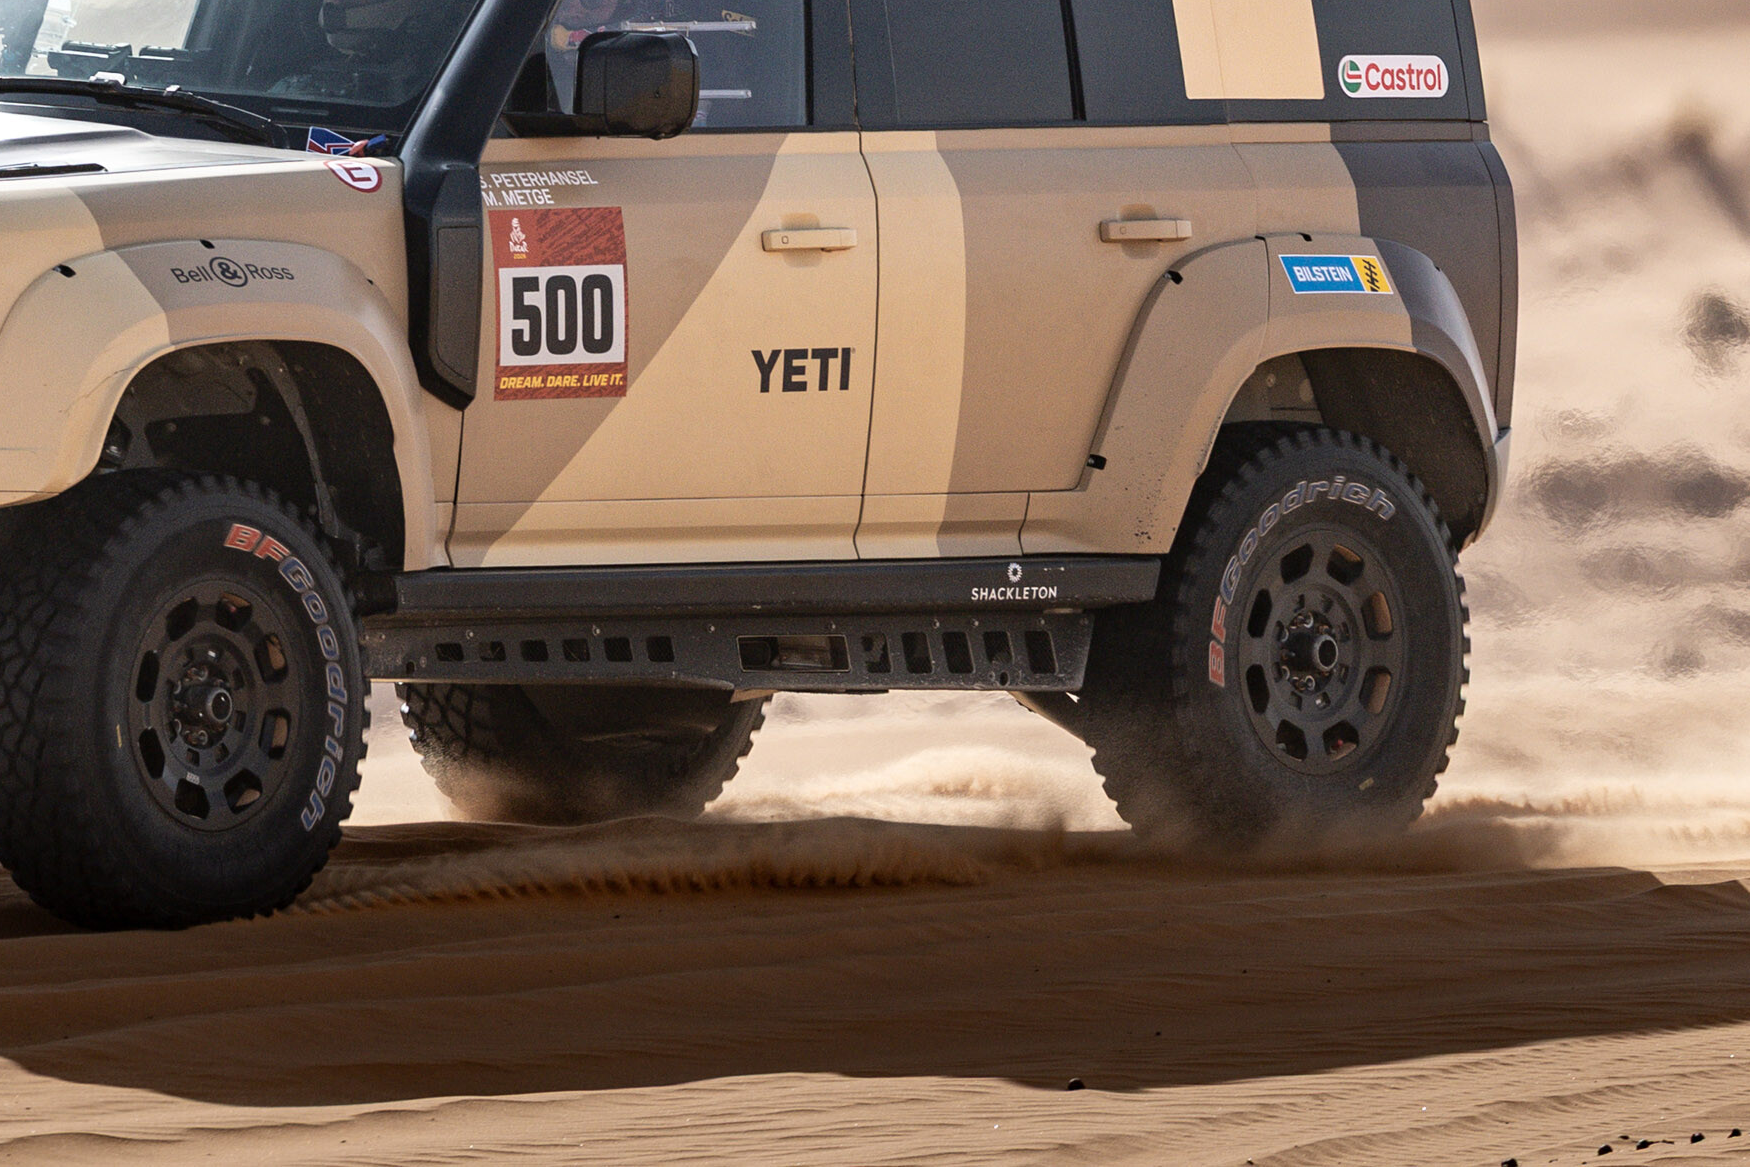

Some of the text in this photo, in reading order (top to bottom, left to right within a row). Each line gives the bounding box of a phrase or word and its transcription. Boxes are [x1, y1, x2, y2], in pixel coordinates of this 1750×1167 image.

[1364, 63, 1442, 91] Castrol
[480, 170, 598, 189] S. PETERHANSEL
[481, 188, 555, 207] M. METGE
[170, 265, 214, 284] Bell
[244, 263, 295, 281] Ross
[1292, 266, 1354, 282] BILSTEIN
[511, 274, 614, 356] 500
[751, 347, 851, 393] YETI
[499, 373, 623, 389] DREAM. DARE. LIVE IT.
[1208, 475, 1397, 688] BFGoodrich
[971, 586, 1058, 601] SHACKLETON
[223, 523, 348, 832] BFGoodrich
